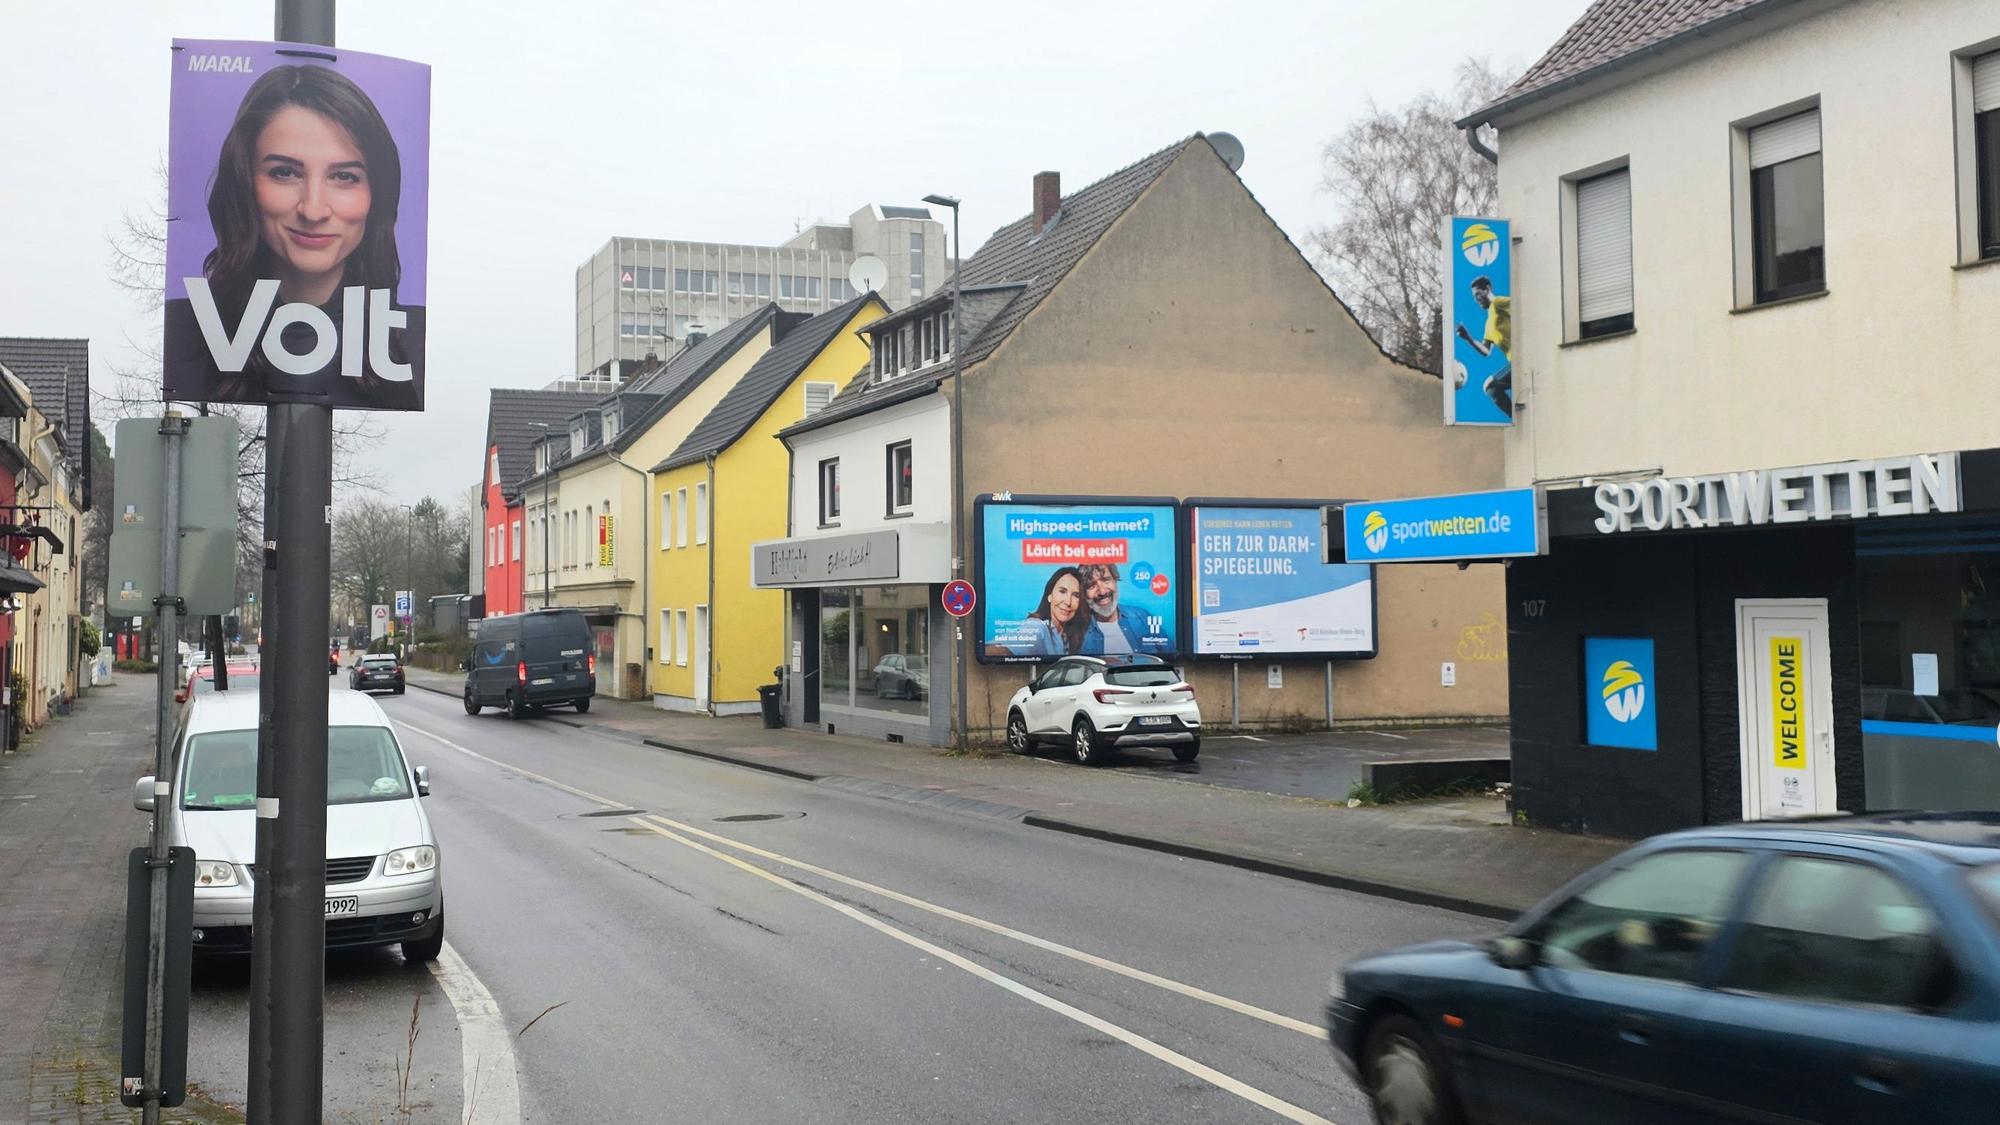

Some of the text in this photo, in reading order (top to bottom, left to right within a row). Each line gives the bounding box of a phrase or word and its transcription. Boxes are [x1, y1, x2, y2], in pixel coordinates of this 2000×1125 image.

[188, 54, 254, 74] MARAL
[182, 277, 413, 382] Volt
[992, 490, 1012, 502] awk
[1594, 451, 1960, 534] SPORTWETTEN
[1010, 517, 1151, 536] Highspeed-Internet?
[1391, 510, 1511, 544] sportwetten.de
[1026, 543, 1124, 558] Läuft bei euch!
[1204, 535, 1317, 553] GEH ZUR DARM-
[1204, 557, 1298, 575] SPIEGELUNG.
[1133, 571, 1151, 581] 250
[1521, 599, 1547, 618] 107
[1778, 643, 1798, 760] WELCOME
[324, 898, 356, 914] 1992
